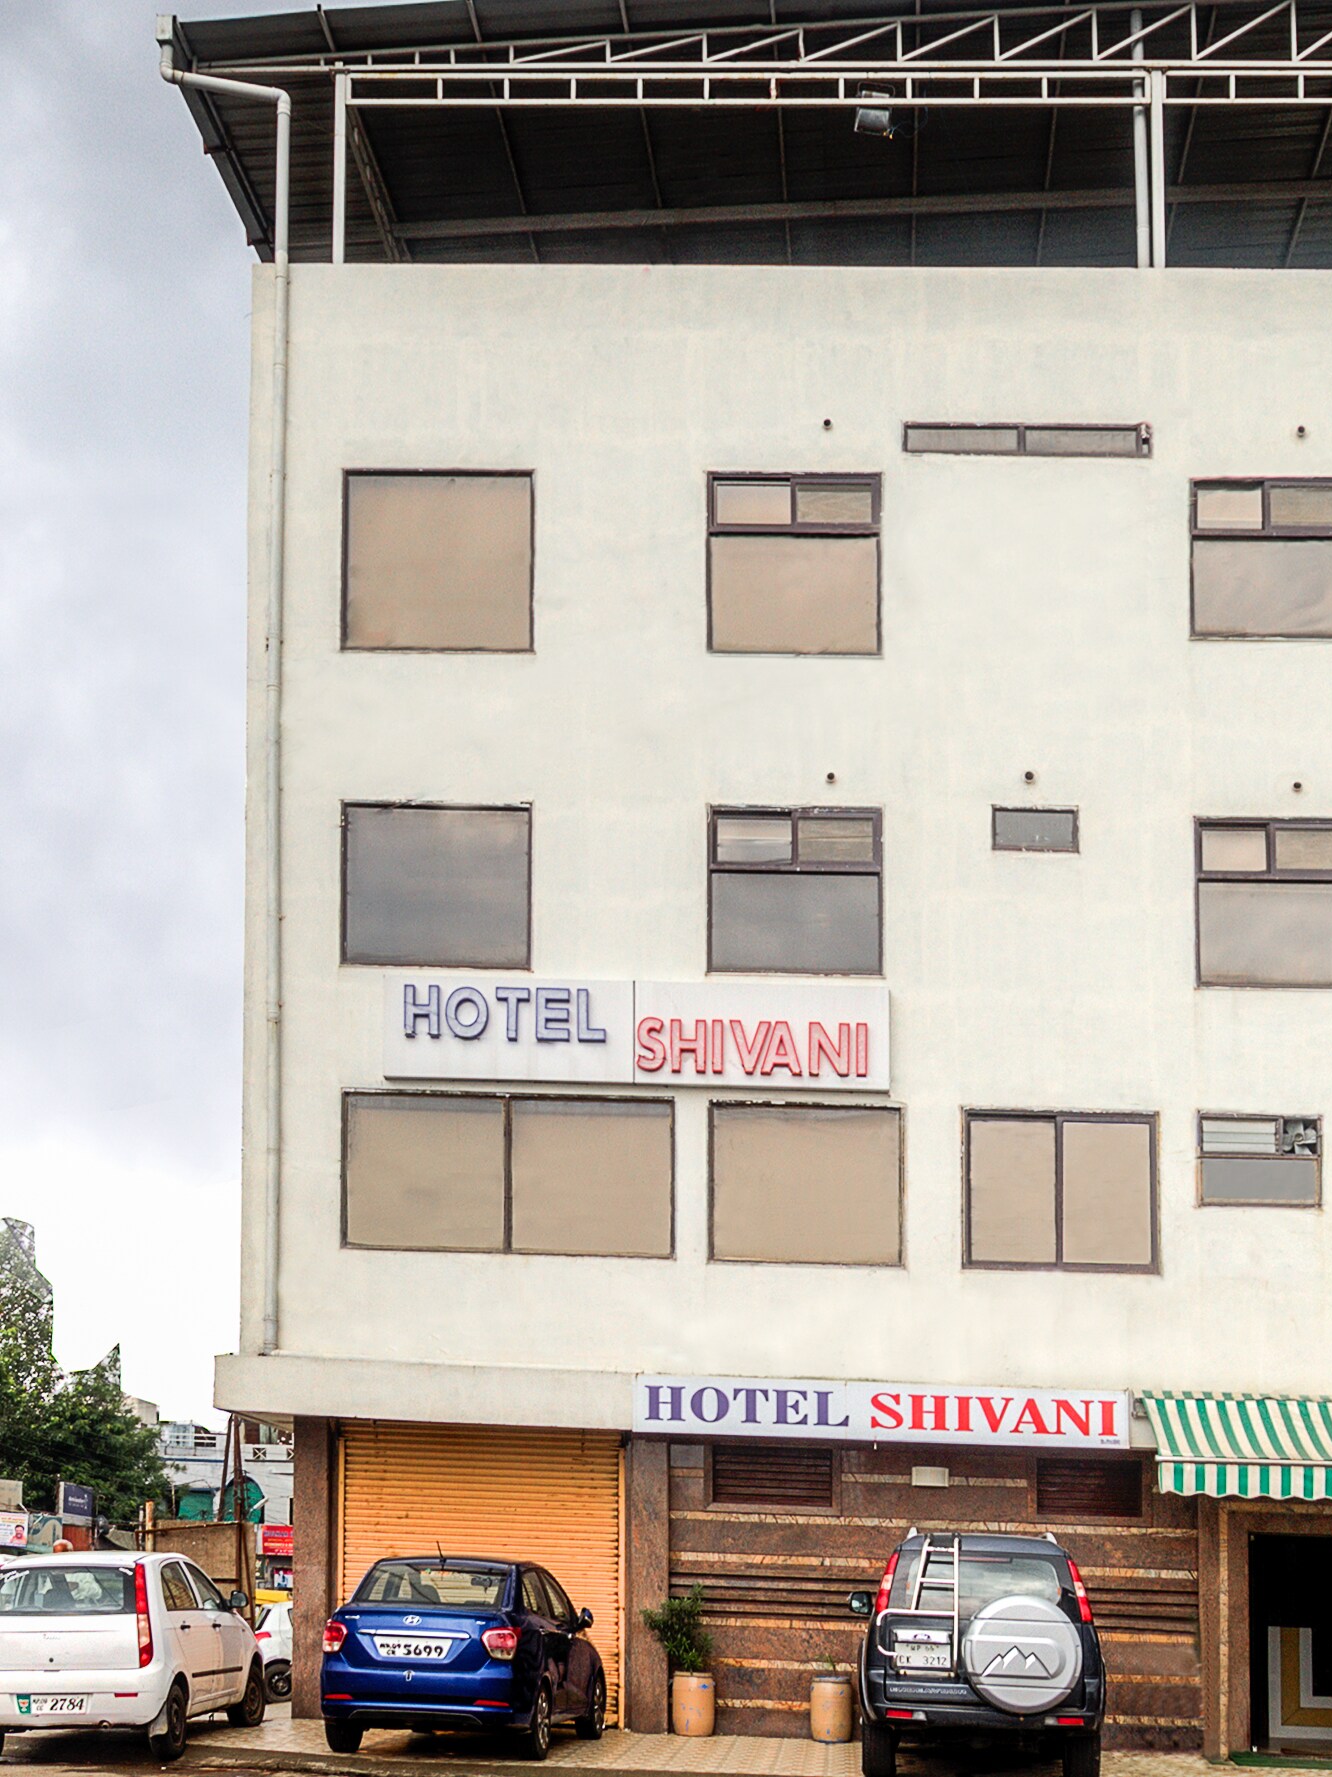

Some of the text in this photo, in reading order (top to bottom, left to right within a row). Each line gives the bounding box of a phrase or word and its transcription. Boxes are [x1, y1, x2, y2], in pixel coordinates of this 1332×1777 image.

[404, 984, 869, 1077] HOTEL SHIVANI
[644, 1384, 1118, 1437] HOTEL SHIVANI
[402, 1643, 444, 1657] 5699
[922, 1655, 947, 1666] 3212
[49, 1697, 85, 1711] 2784
